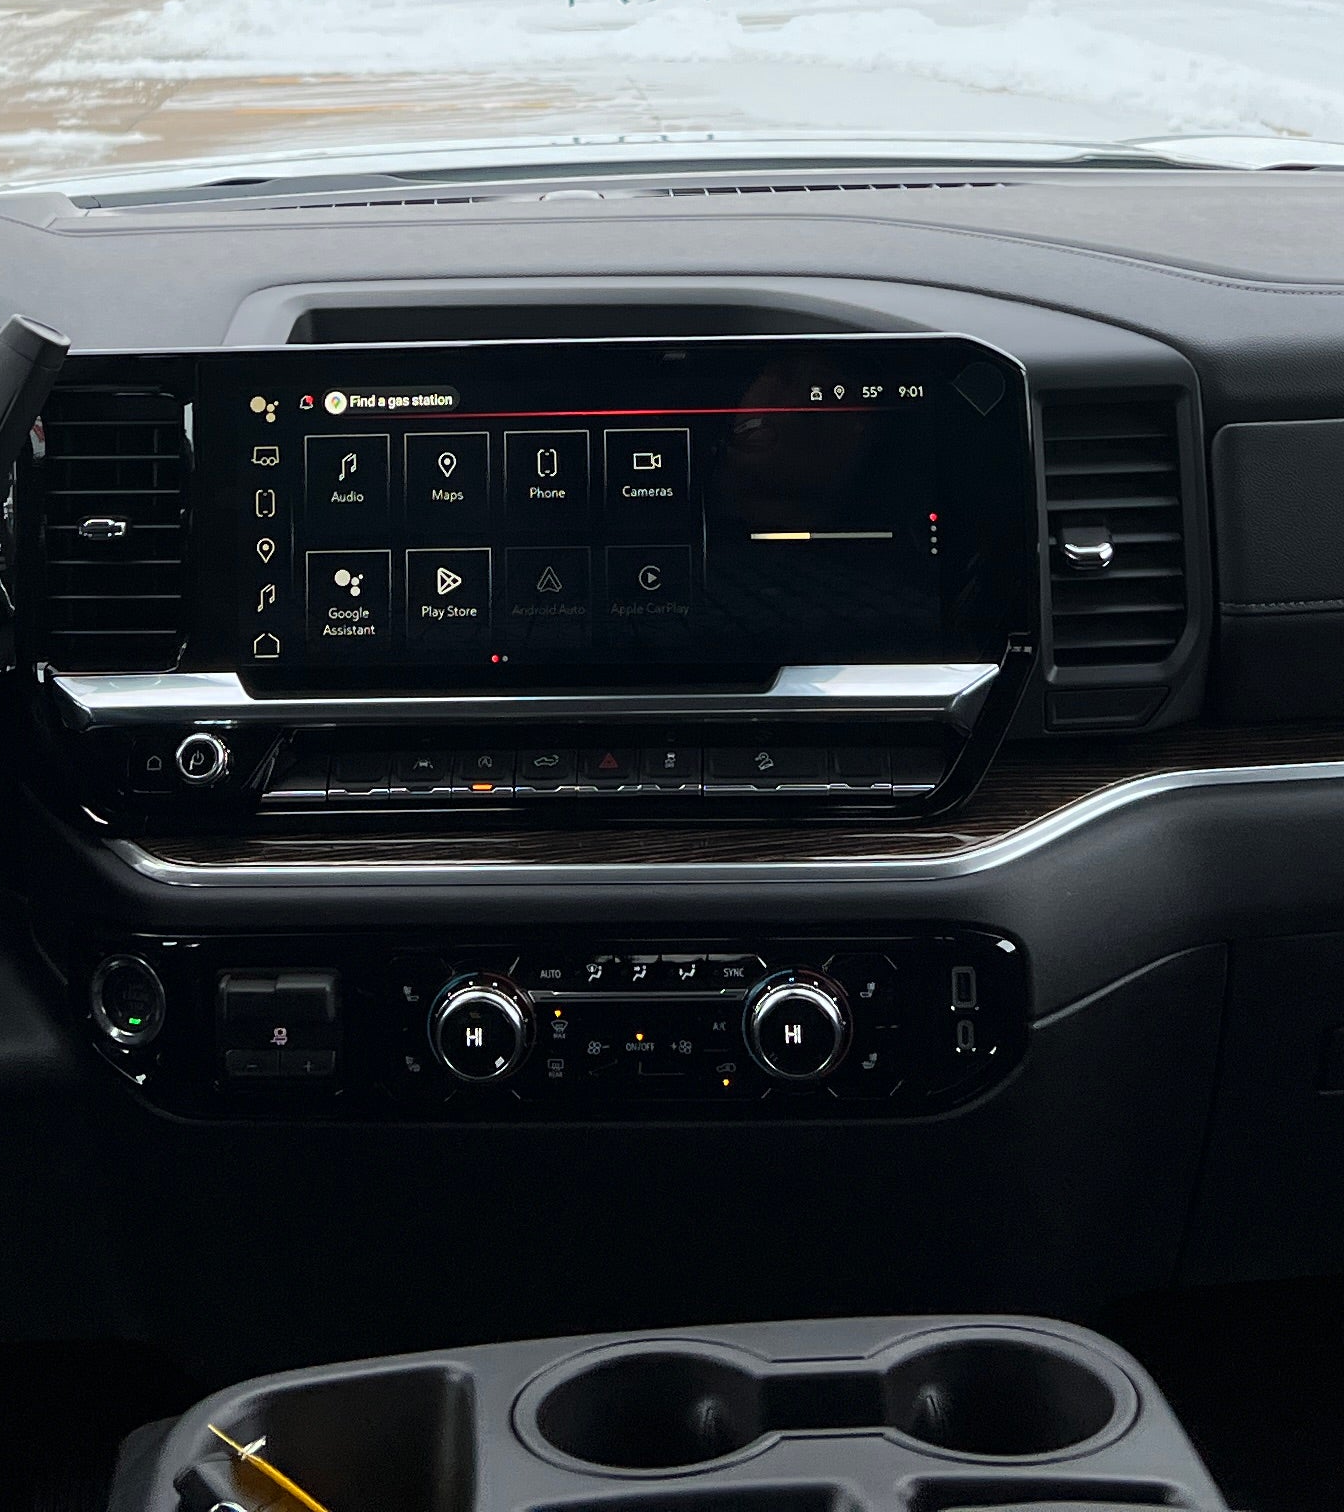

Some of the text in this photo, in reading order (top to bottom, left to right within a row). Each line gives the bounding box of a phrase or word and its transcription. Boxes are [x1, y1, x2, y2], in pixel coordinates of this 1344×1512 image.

[862, 385, 883, 398] 55°
[899, 385, 924, 398] 9:01
[350, 394, 453, 409] Find a gas station
[331, 490, 364, 503] Audio
[432, 489, 464, 503] Maps
[529, 486, 566, 499] Phone
[622, 485, 674, 498] Cameras
[328, 606, 370, 622] Google
[421, 605, 478, 620] Play Store
[512, 603, 586, 616] Android Auto
[610, 602, 690, 616] Apple CarPlay
[322, 624, 376, 636] Assistant
[540, 969, 562, 979] AUTO
[723, 967, 745, 978] SYNC
[466, 1027, 483, 1047] HI
[784, 1025, 802, 1044] HI
[625, 1041, 655, 1052] ON/OFF
